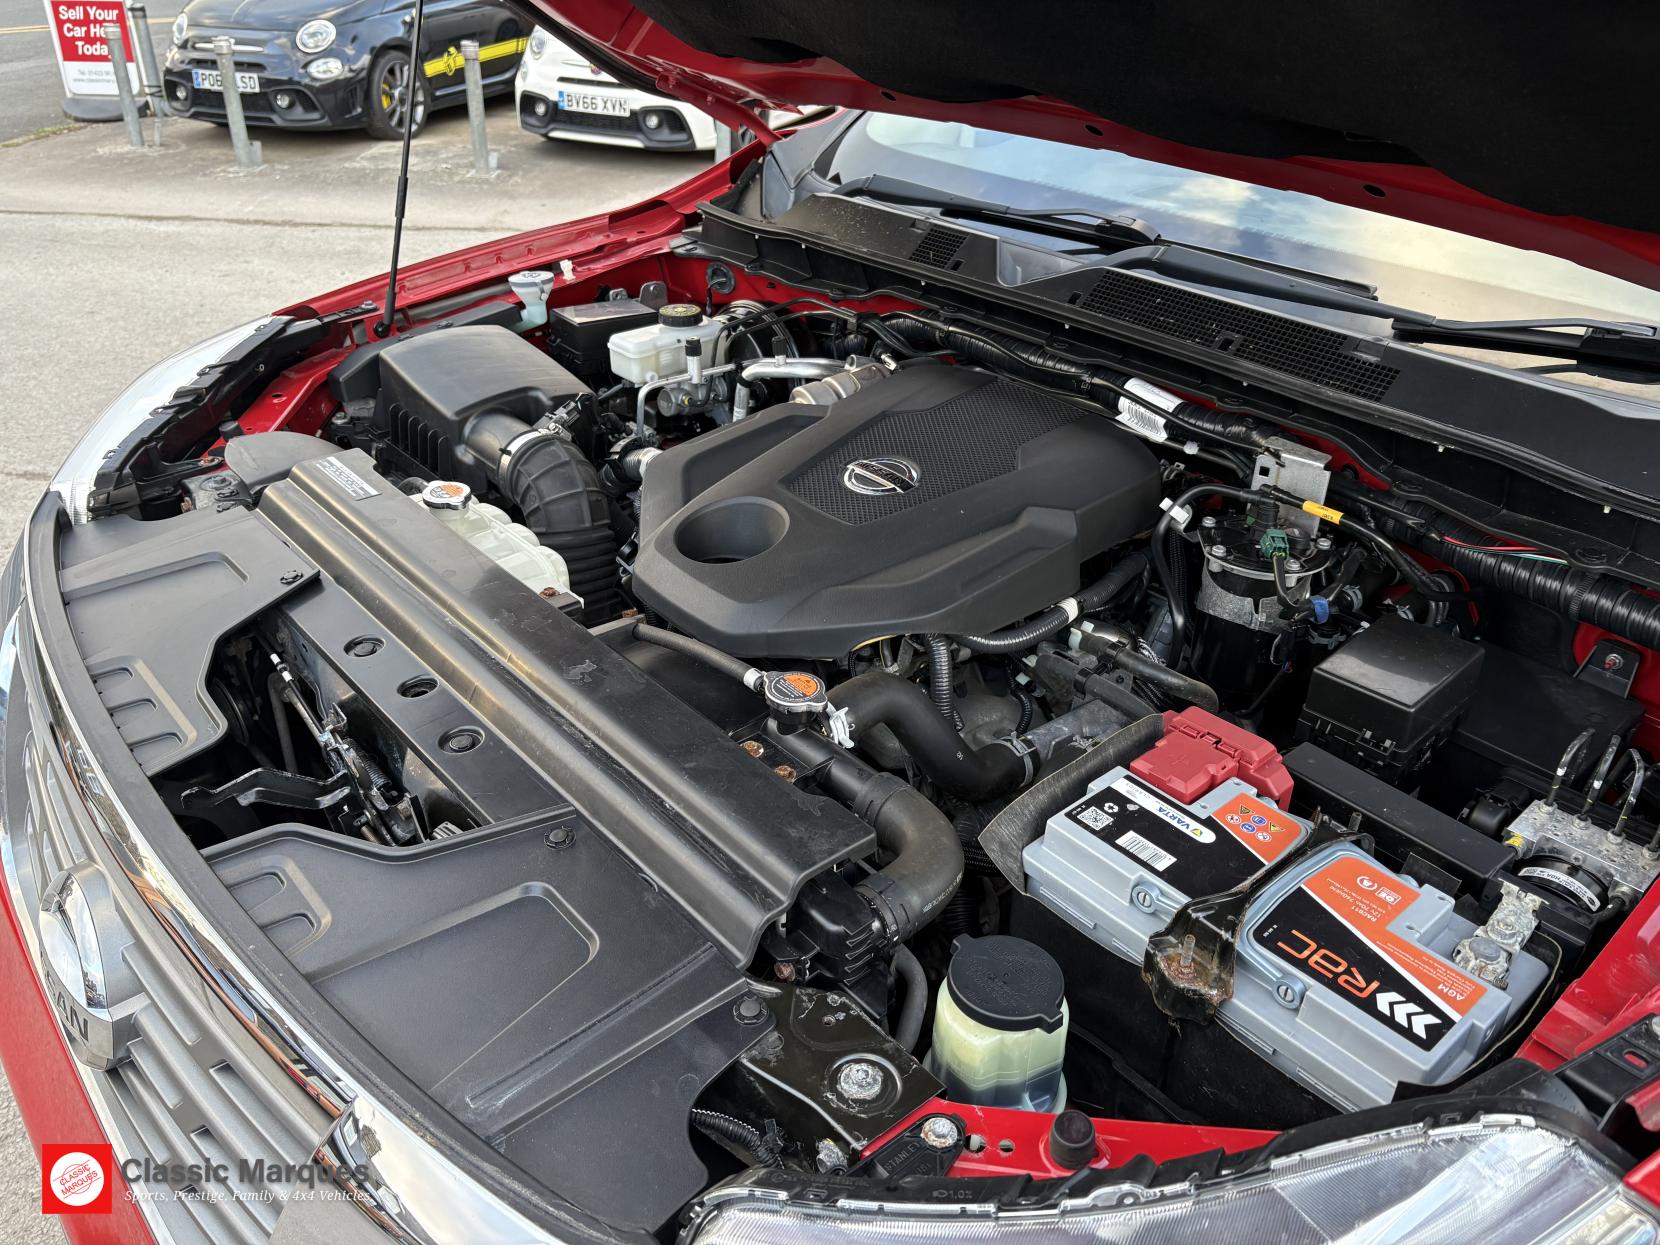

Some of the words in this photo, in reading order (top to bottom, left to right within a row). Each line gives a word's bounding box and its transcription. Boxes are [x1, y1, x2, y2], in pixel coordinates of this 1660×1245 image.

[58, 5, 84, 20] Sell
[86, 6, 119, 20] Your
[63, 23, 87, 38] Car
[75, 41, 112, 59] Toda
[201, 73, 222, 87] PO6
[567, 94, 597, 110] BV66
[601, 98, 628, 113] XVN
[1158, 806, 1190, 829] VARTA
[1438, 983, 1466, 1001] AGM
